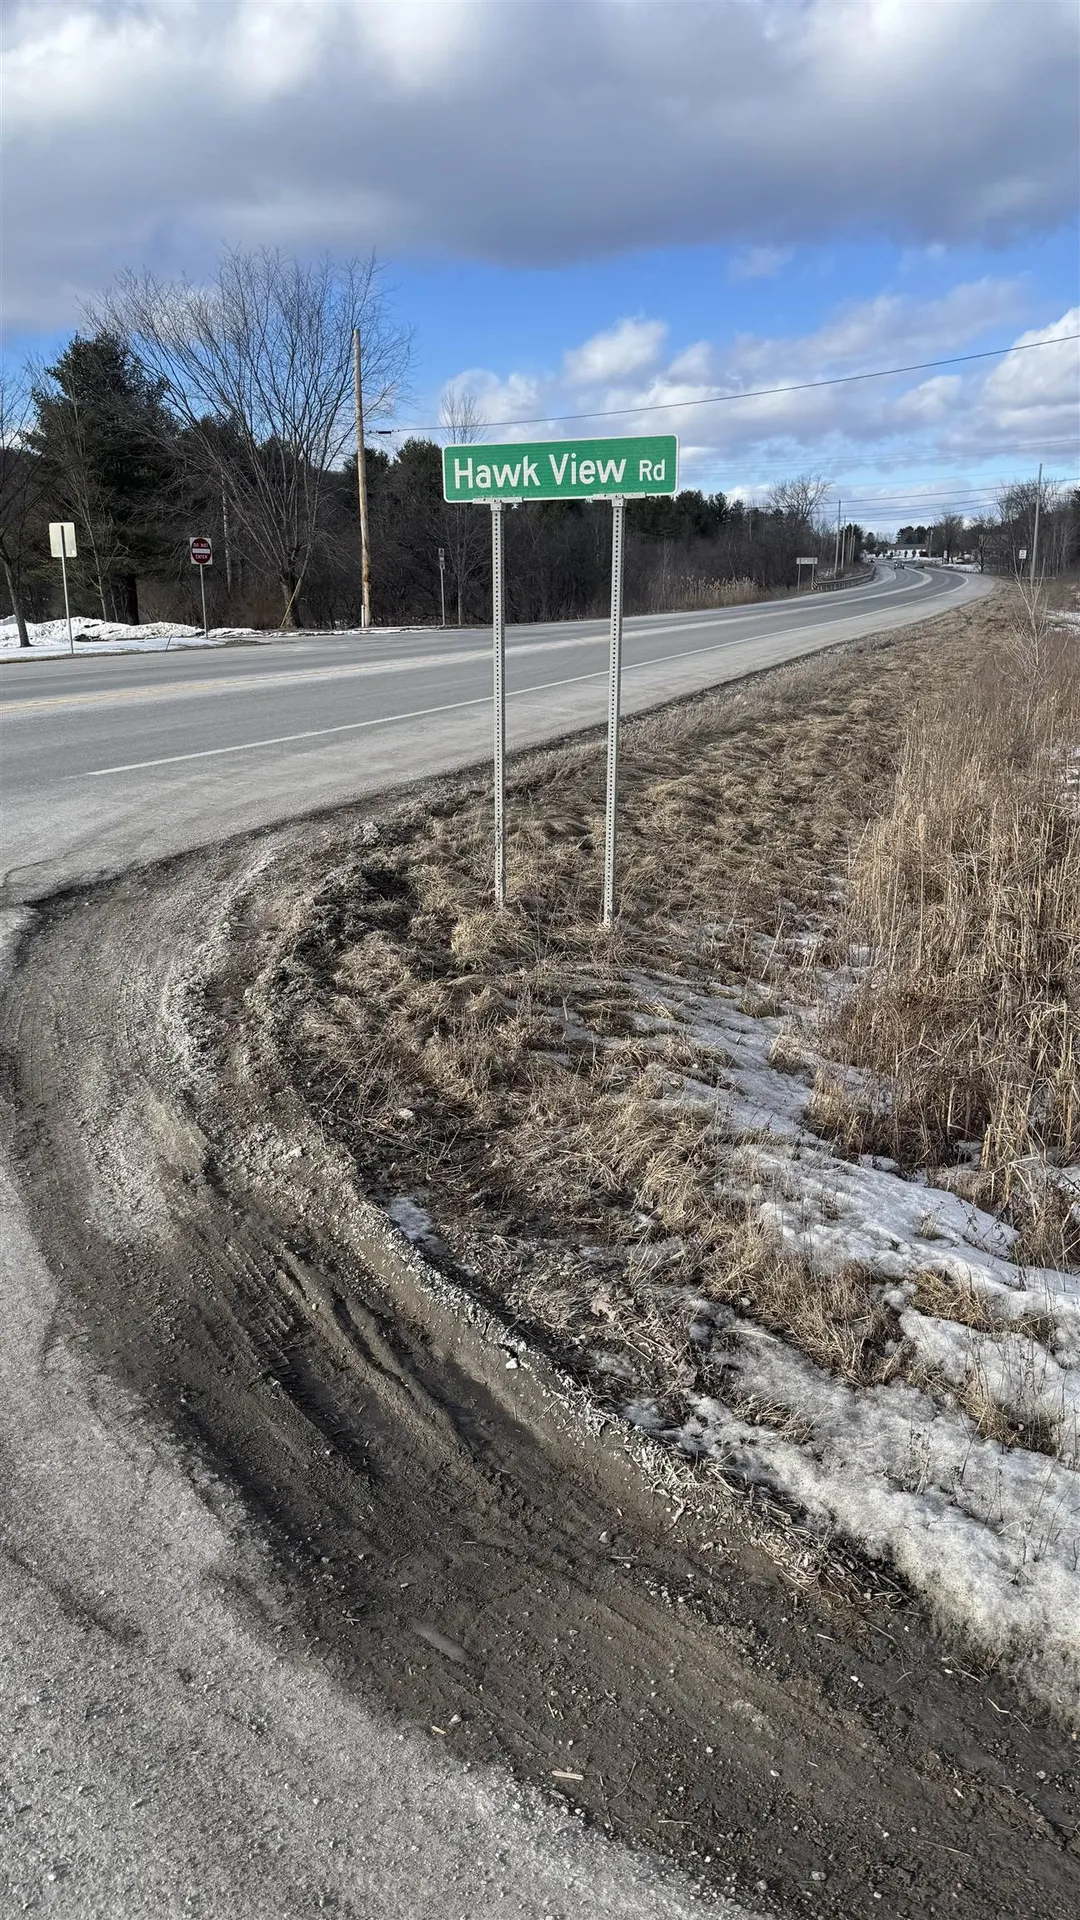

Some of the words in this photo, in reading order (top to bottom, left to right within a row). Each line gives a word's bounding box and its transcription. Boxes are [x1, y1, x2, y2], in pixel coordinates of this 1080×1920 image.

[454, 455, 541, 489] Hawk
[548, 453, 627, 486] View
[639, 459, 666, 482] Rd
